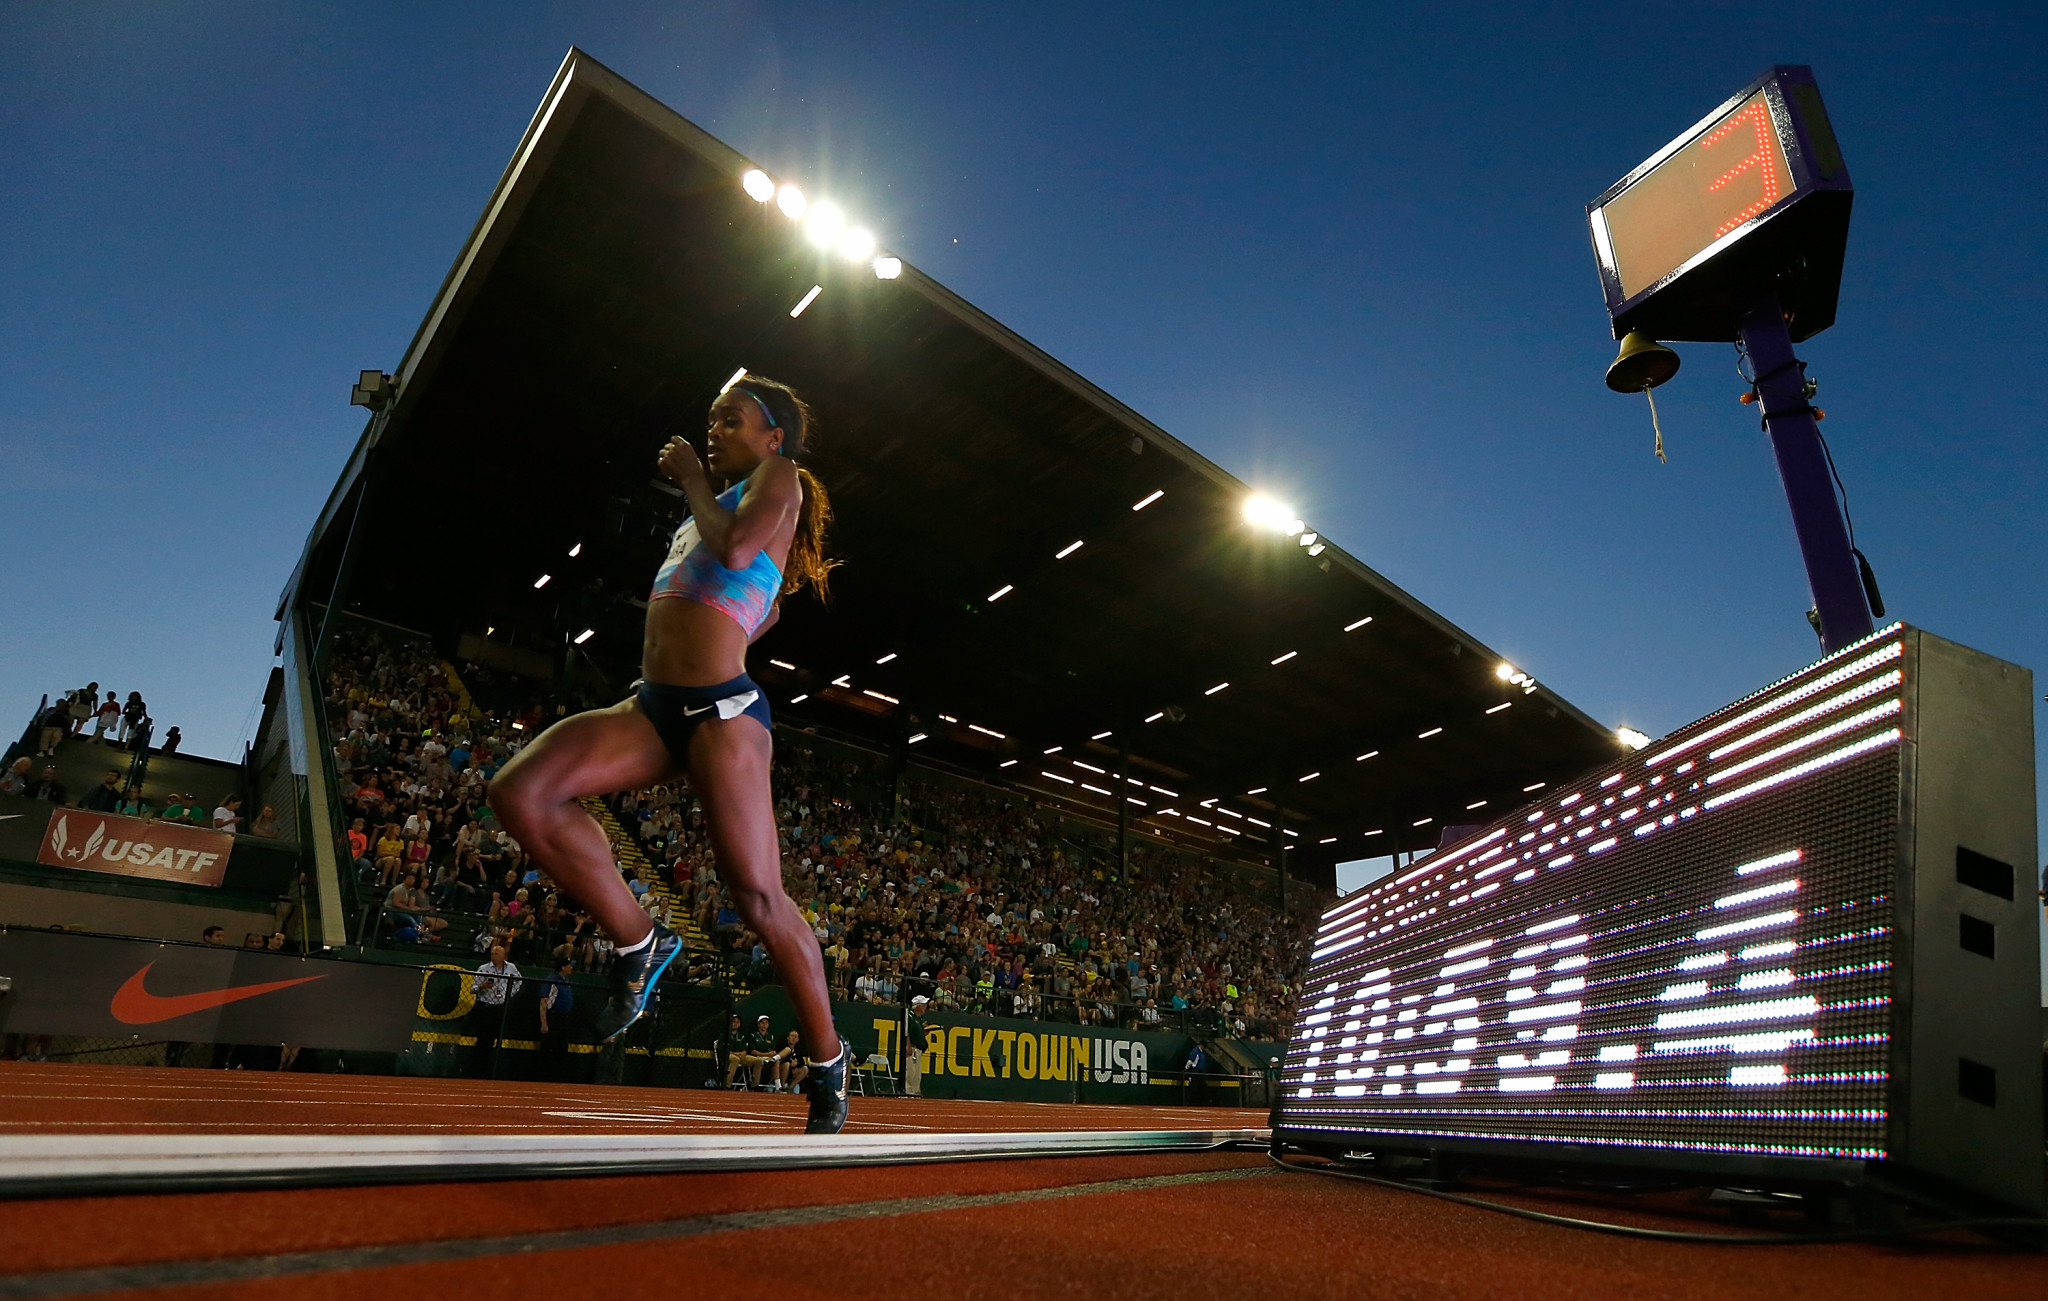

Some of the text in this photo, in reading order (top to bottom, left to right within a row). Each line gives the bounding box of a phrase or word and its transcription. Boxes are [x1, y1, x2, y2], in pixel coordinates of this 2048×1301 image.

[1701, 103, 1778, 239] 3
[101, 839, 219, 873] USATF
[873, 1018, 1148, 1085] TACKTOWN USA
